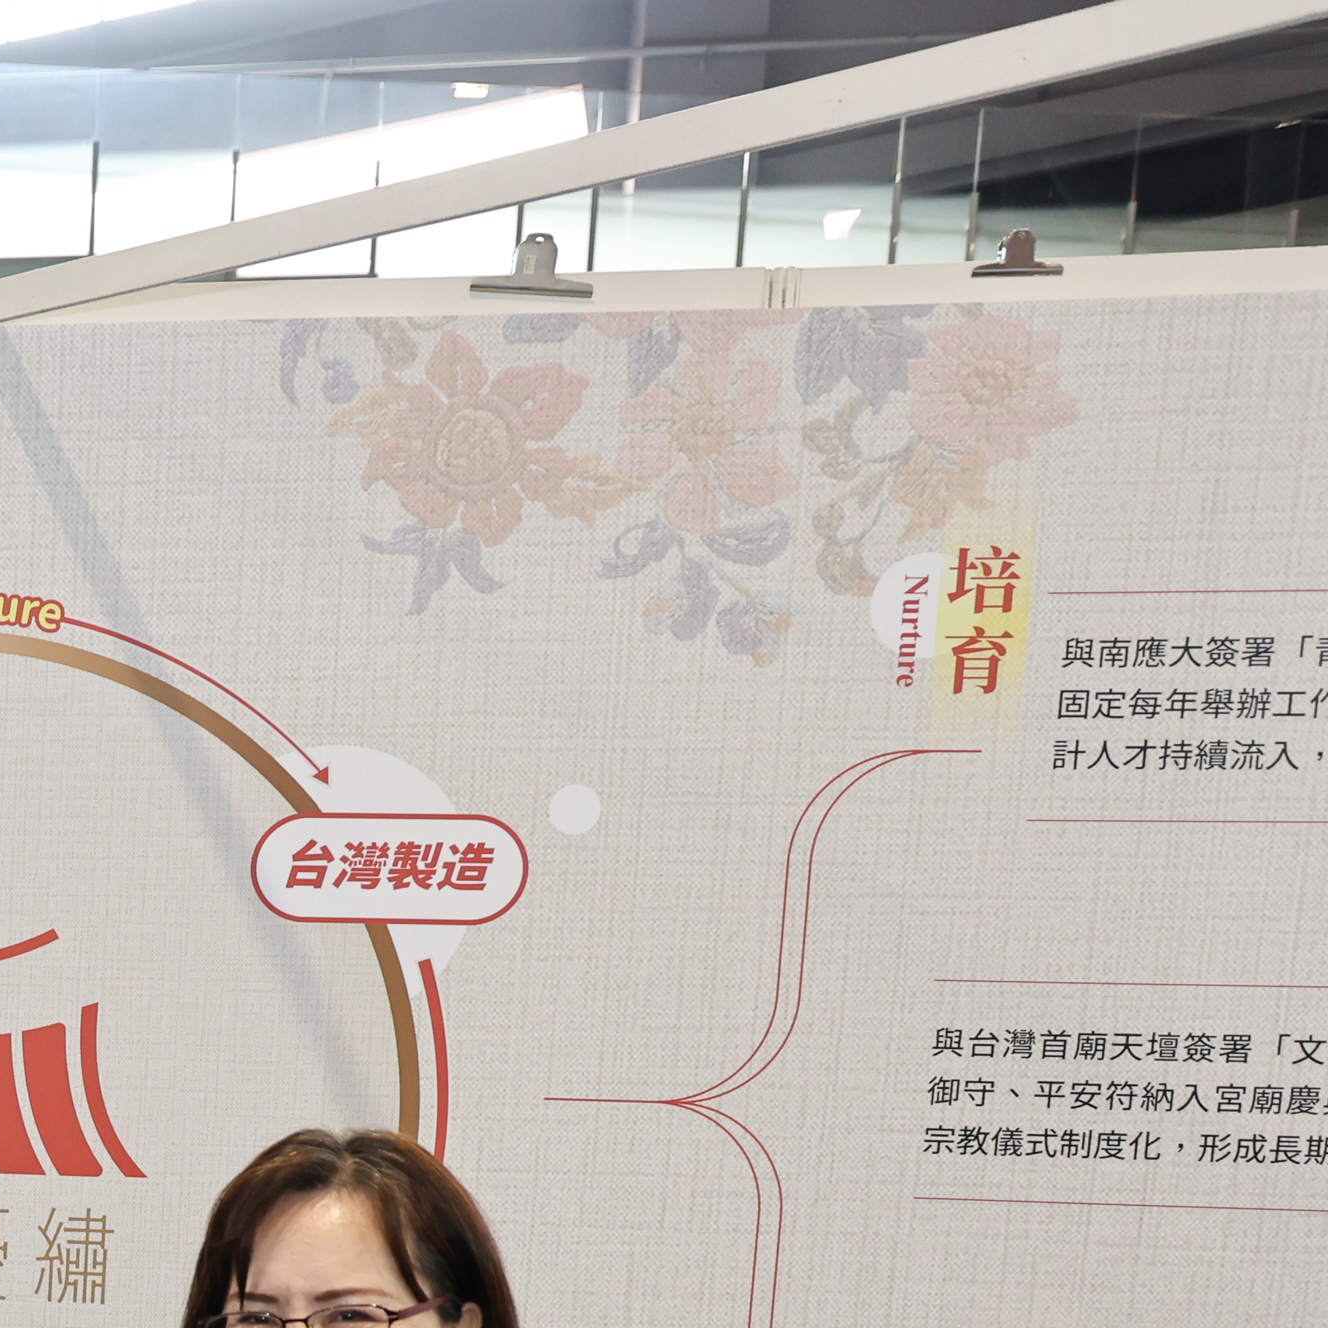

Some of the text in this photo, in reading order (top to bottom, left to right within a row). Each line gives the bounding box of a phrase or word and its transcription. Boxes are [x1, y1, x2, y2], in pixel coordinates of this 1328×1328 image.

[895, 573, 930, 689] Nurture
[945, 545, 1022, 695] 培育
[285, 838, 495, 892] 台灣製造
[926, 1075, 1328, 1117] 御守、平安符納入宮廟慶
